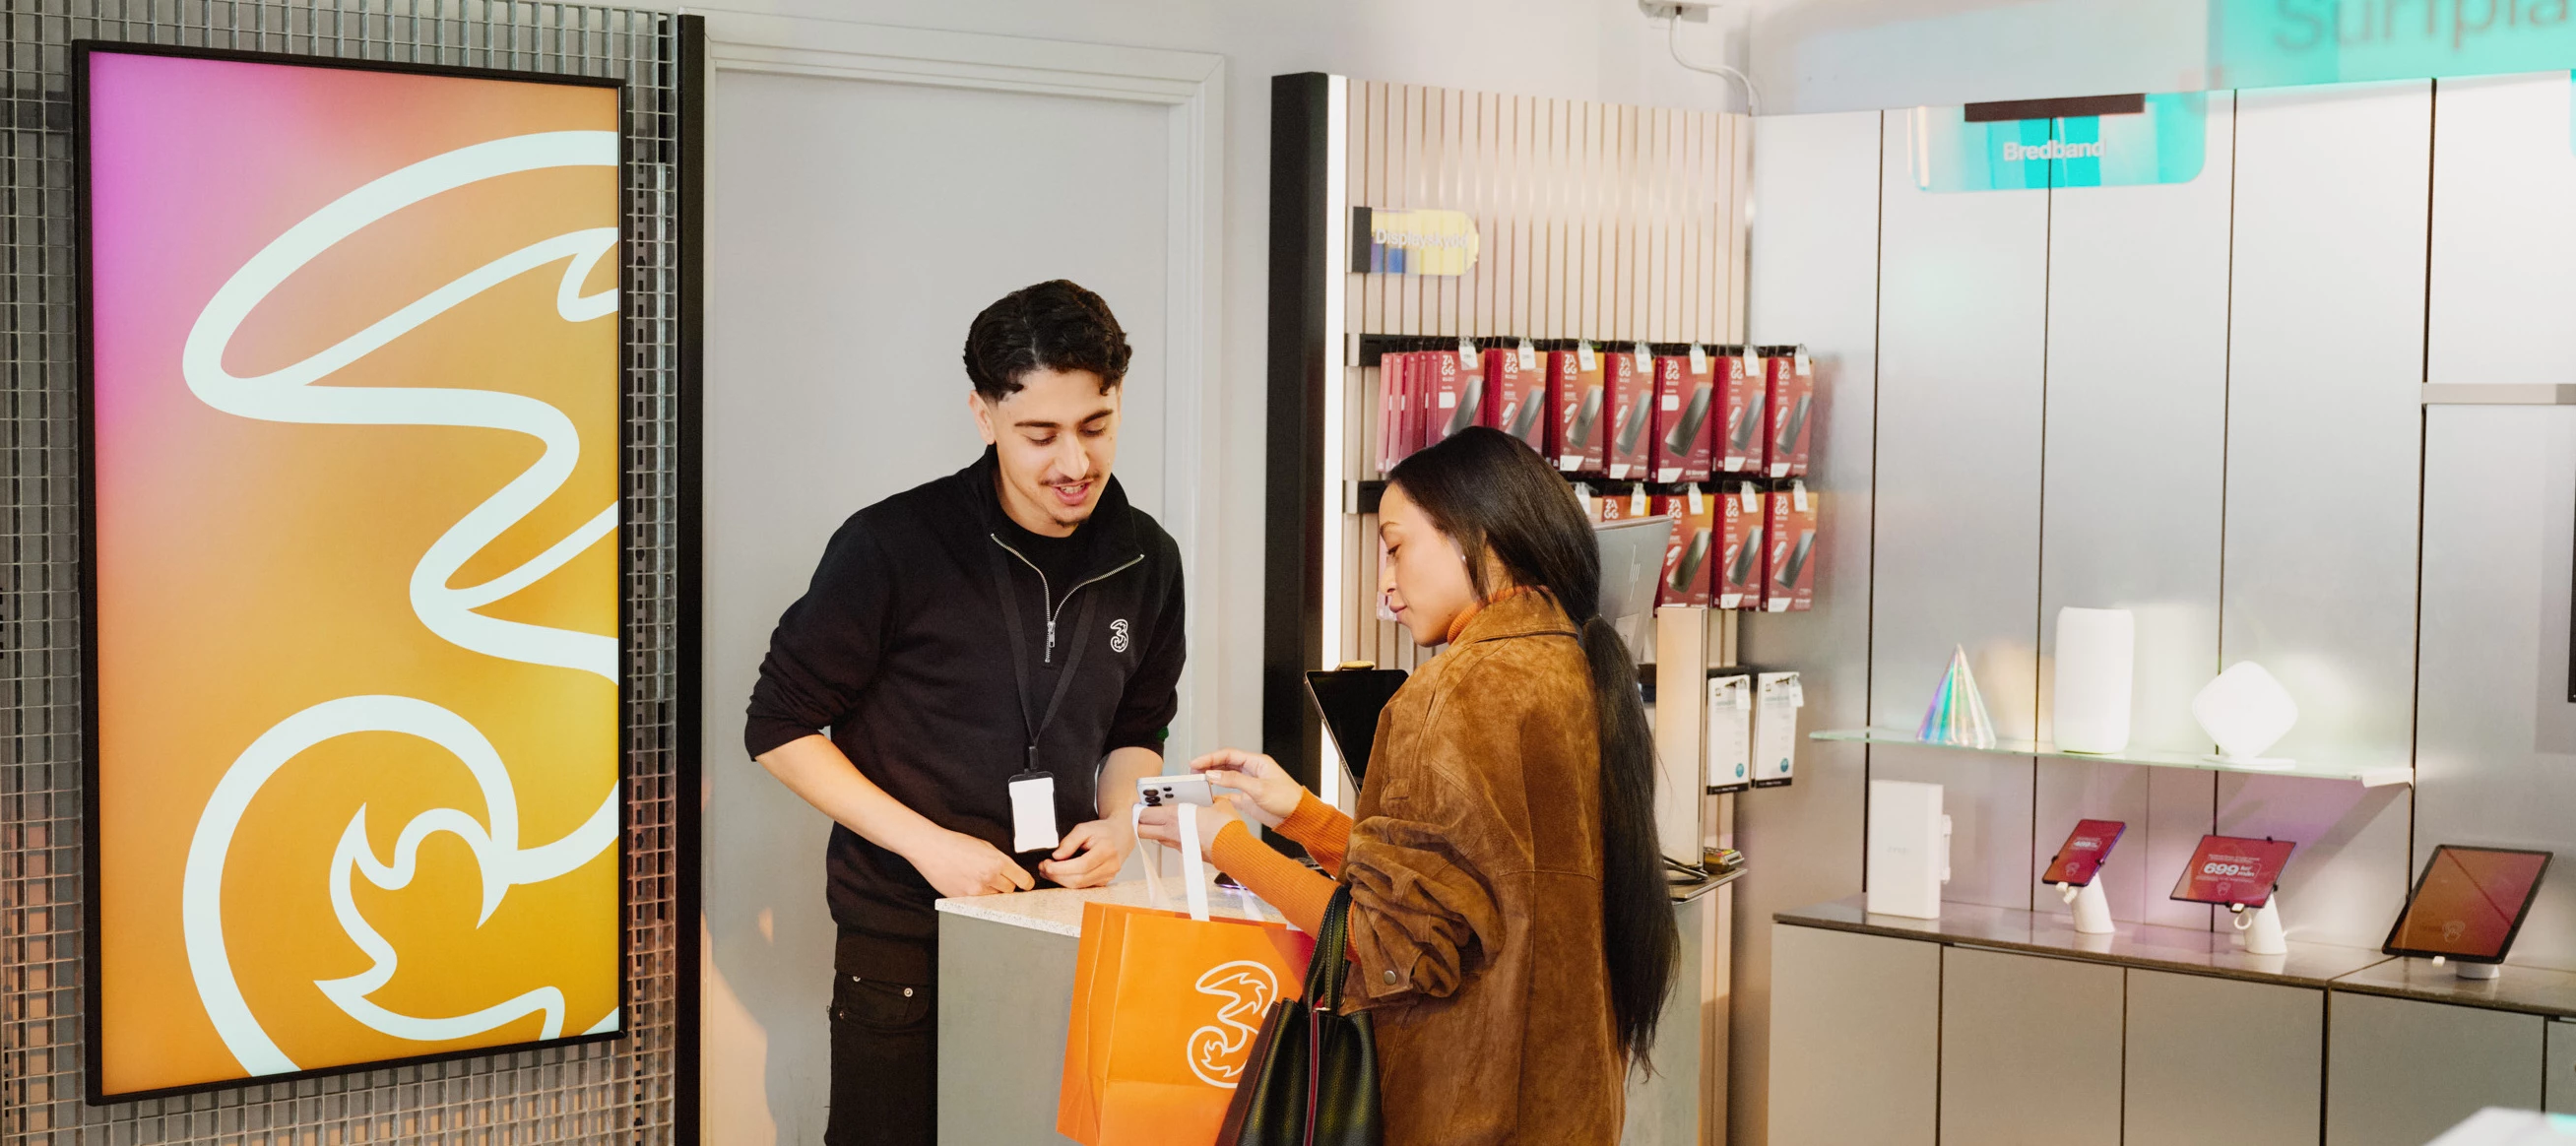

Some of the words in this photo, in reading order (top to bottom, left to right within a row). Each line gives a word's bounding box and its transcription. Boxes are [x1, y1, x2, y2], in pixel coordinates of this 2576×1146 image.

[2003, 139, 2106, 162] Bredband
[1376, 227, 1468, 251] Displayskydd
[2203, 862, 2239, 876] 699
